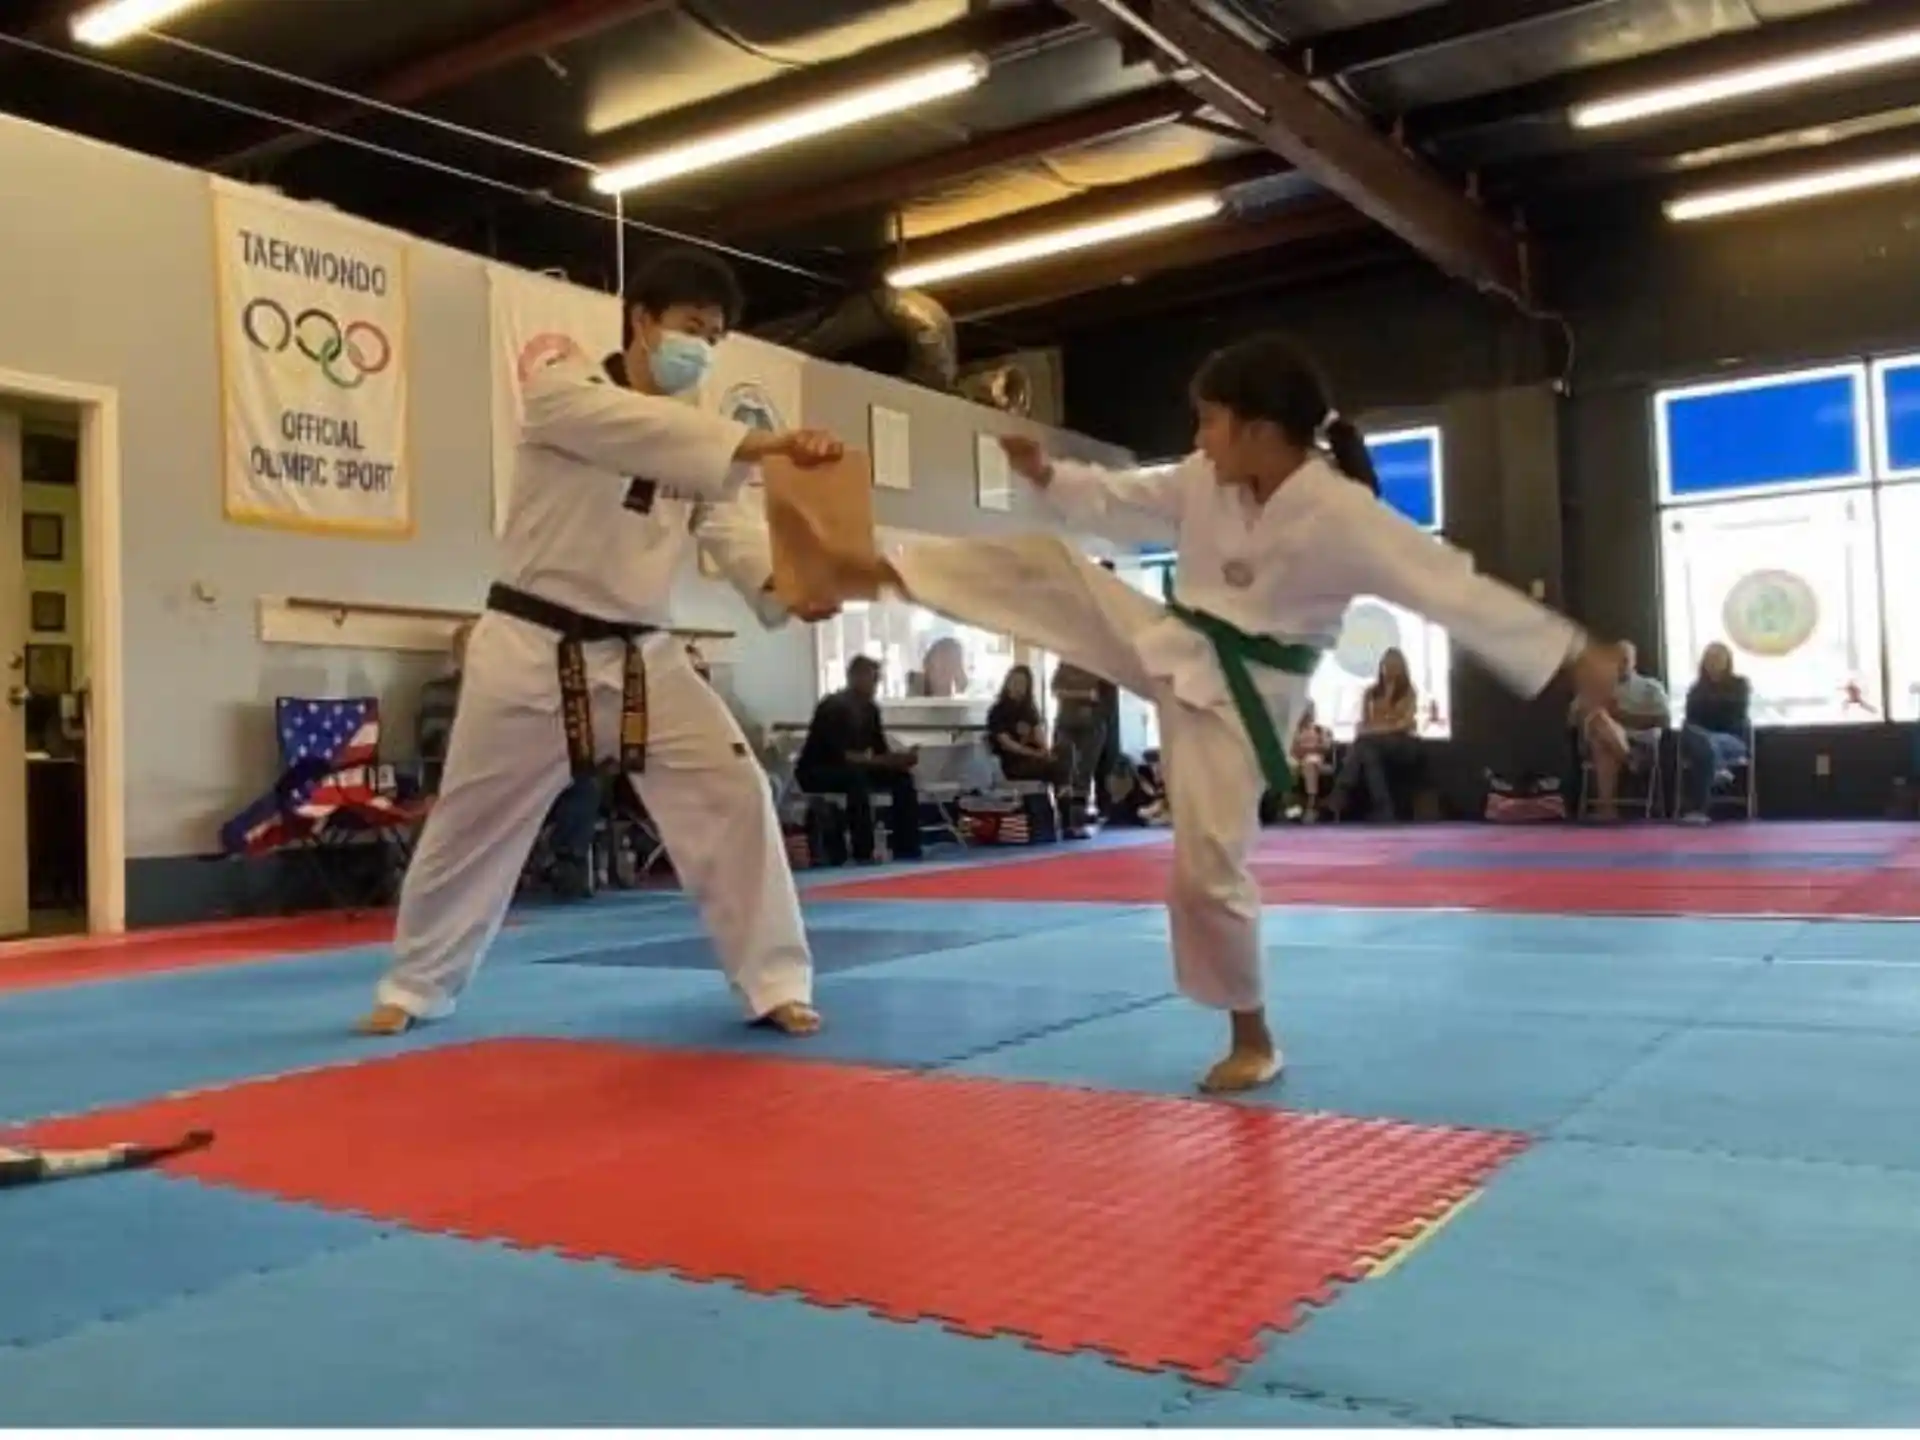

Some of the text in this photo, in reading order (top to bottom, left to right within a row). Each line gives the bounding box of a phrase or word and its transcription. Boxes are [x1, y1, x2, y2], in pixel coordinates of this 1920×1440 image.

[239, 229, 386, 297] TAEKWONDO
[282, 410, 365, 449] OFFICIAL
[251, 445, 394, 493] OLMPIC SPORT
